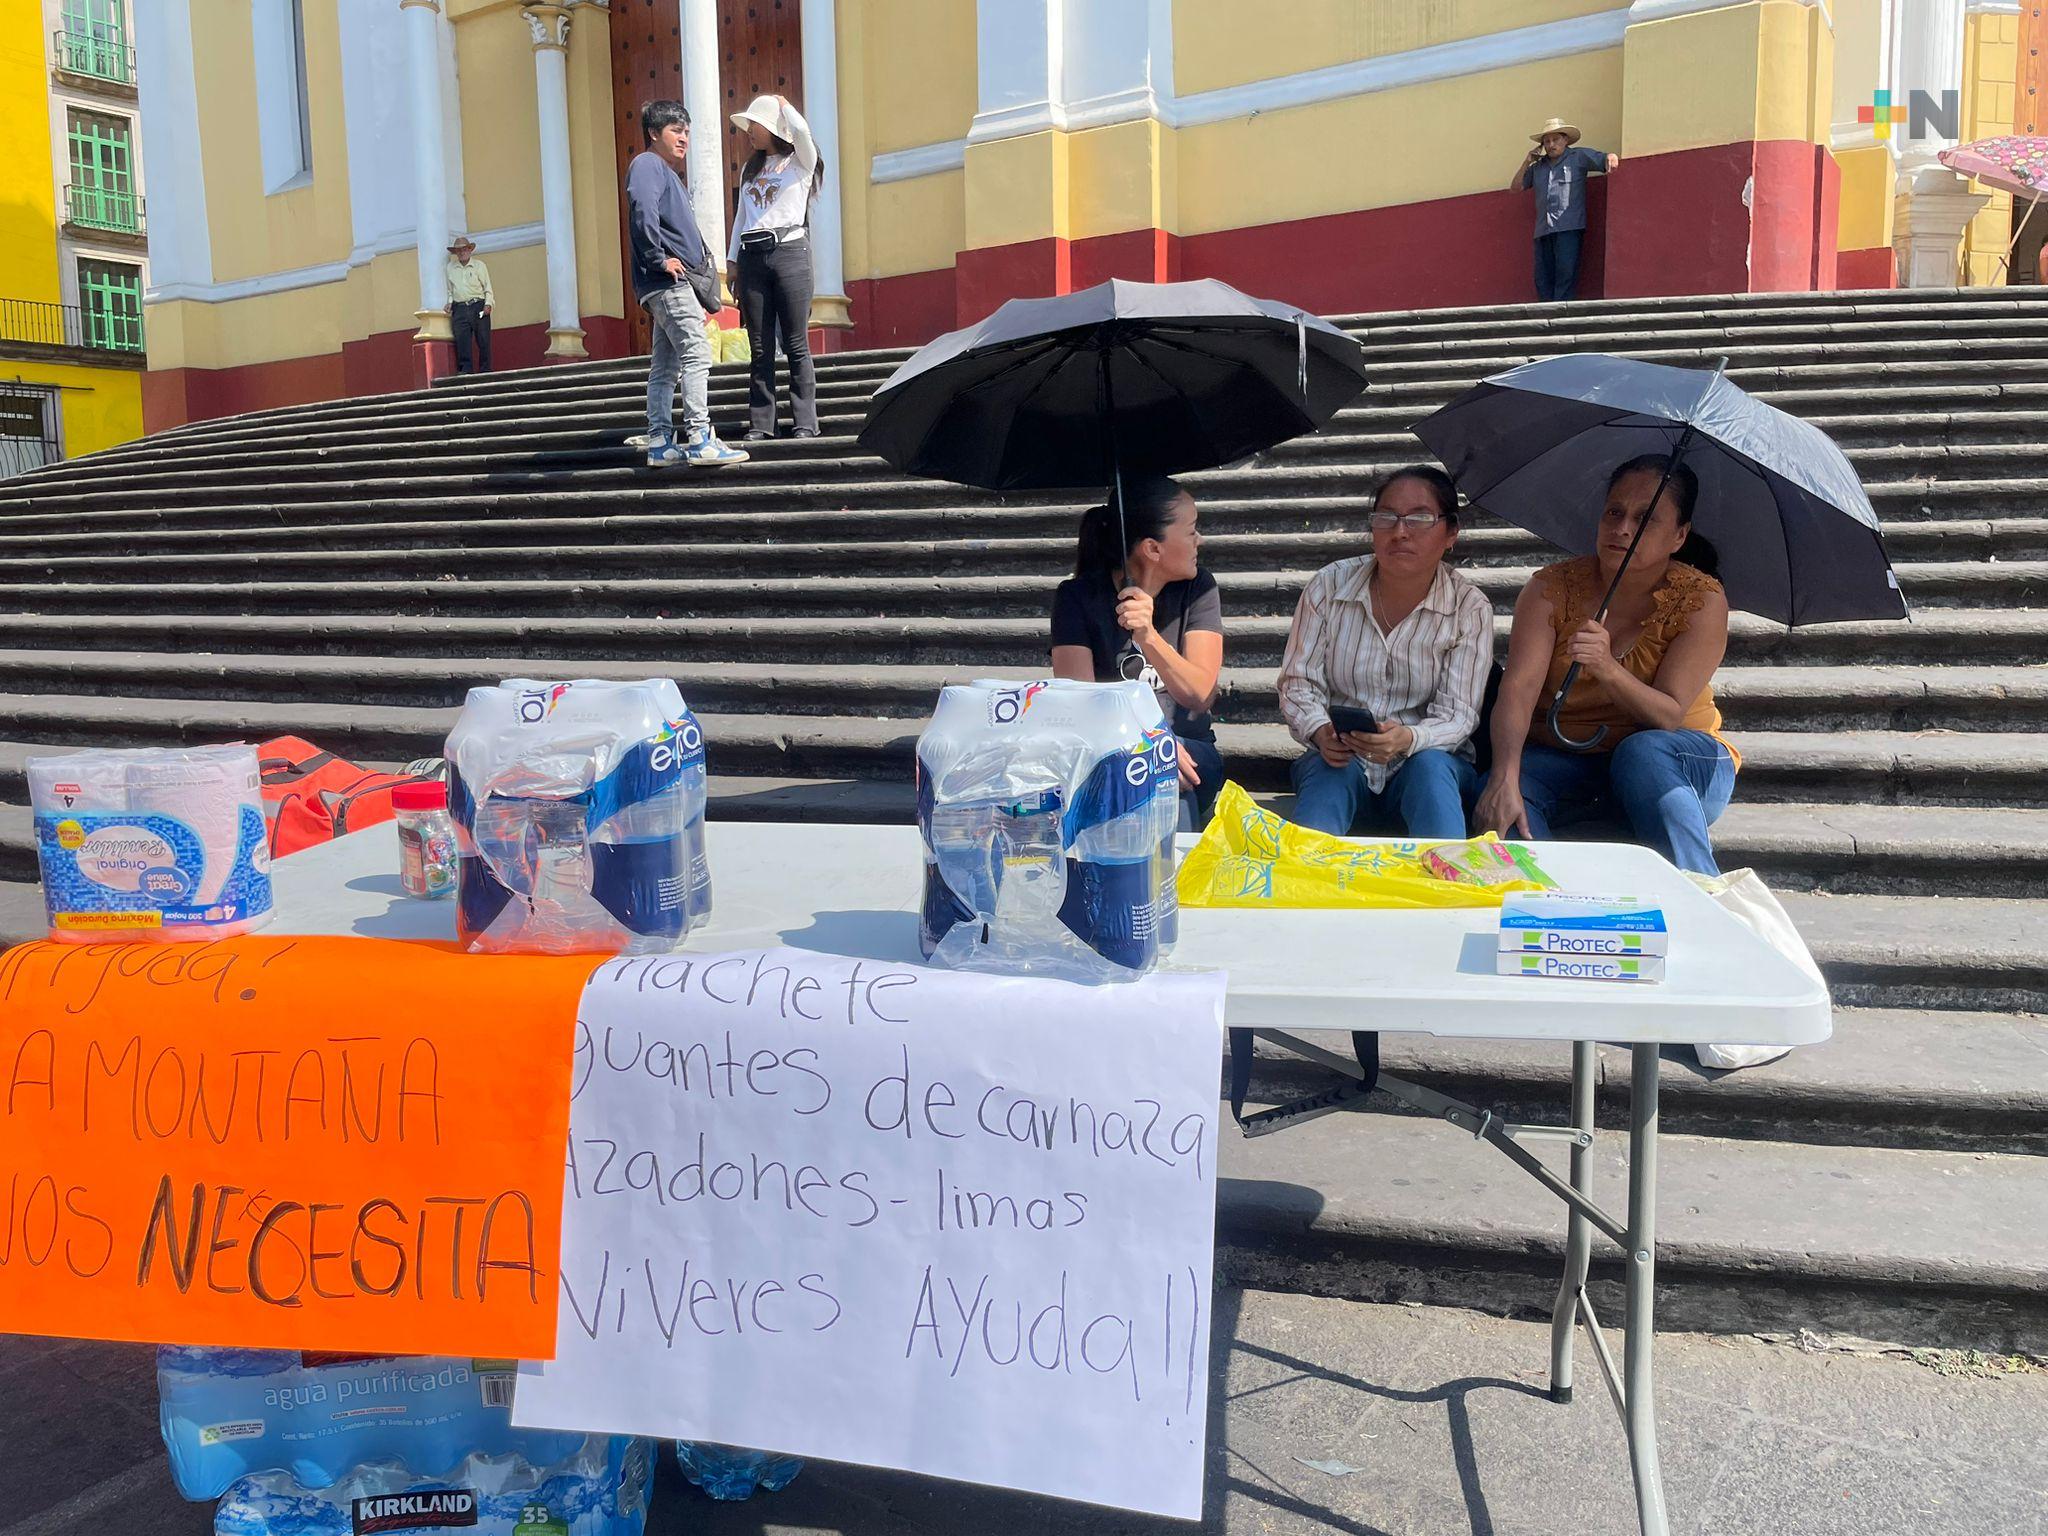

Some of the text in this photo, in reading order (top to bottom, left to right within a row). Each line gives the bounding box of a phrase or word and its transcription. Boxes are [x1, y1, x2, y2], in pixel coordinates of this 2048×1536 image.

[79, 839, 167, 858] Rendidor
[96, 858, 148, 872] Original
[148, 881, 184, 892] Great
[164, 912, 185, 922] hojas
[1547, 933, 1617, 953] PROTEC
[1545, 957, 1615, 978] PROTEC
[586, 954, 918, 1025] machete
[83, 1036, 445, 1146] MONTAÑA
[570, 1020, 832, 1115] guantes
[864, 1044, 965, 1140] de
[937, 1168, 1089, 1231] limas
[137, 1173, 546, 1309] NECESITA
[264, 1363, 472, 1412] agua purificada
[360, 1494, 472, 1521] KIRKLAND
[522, 1506, 549, 1524] 35
